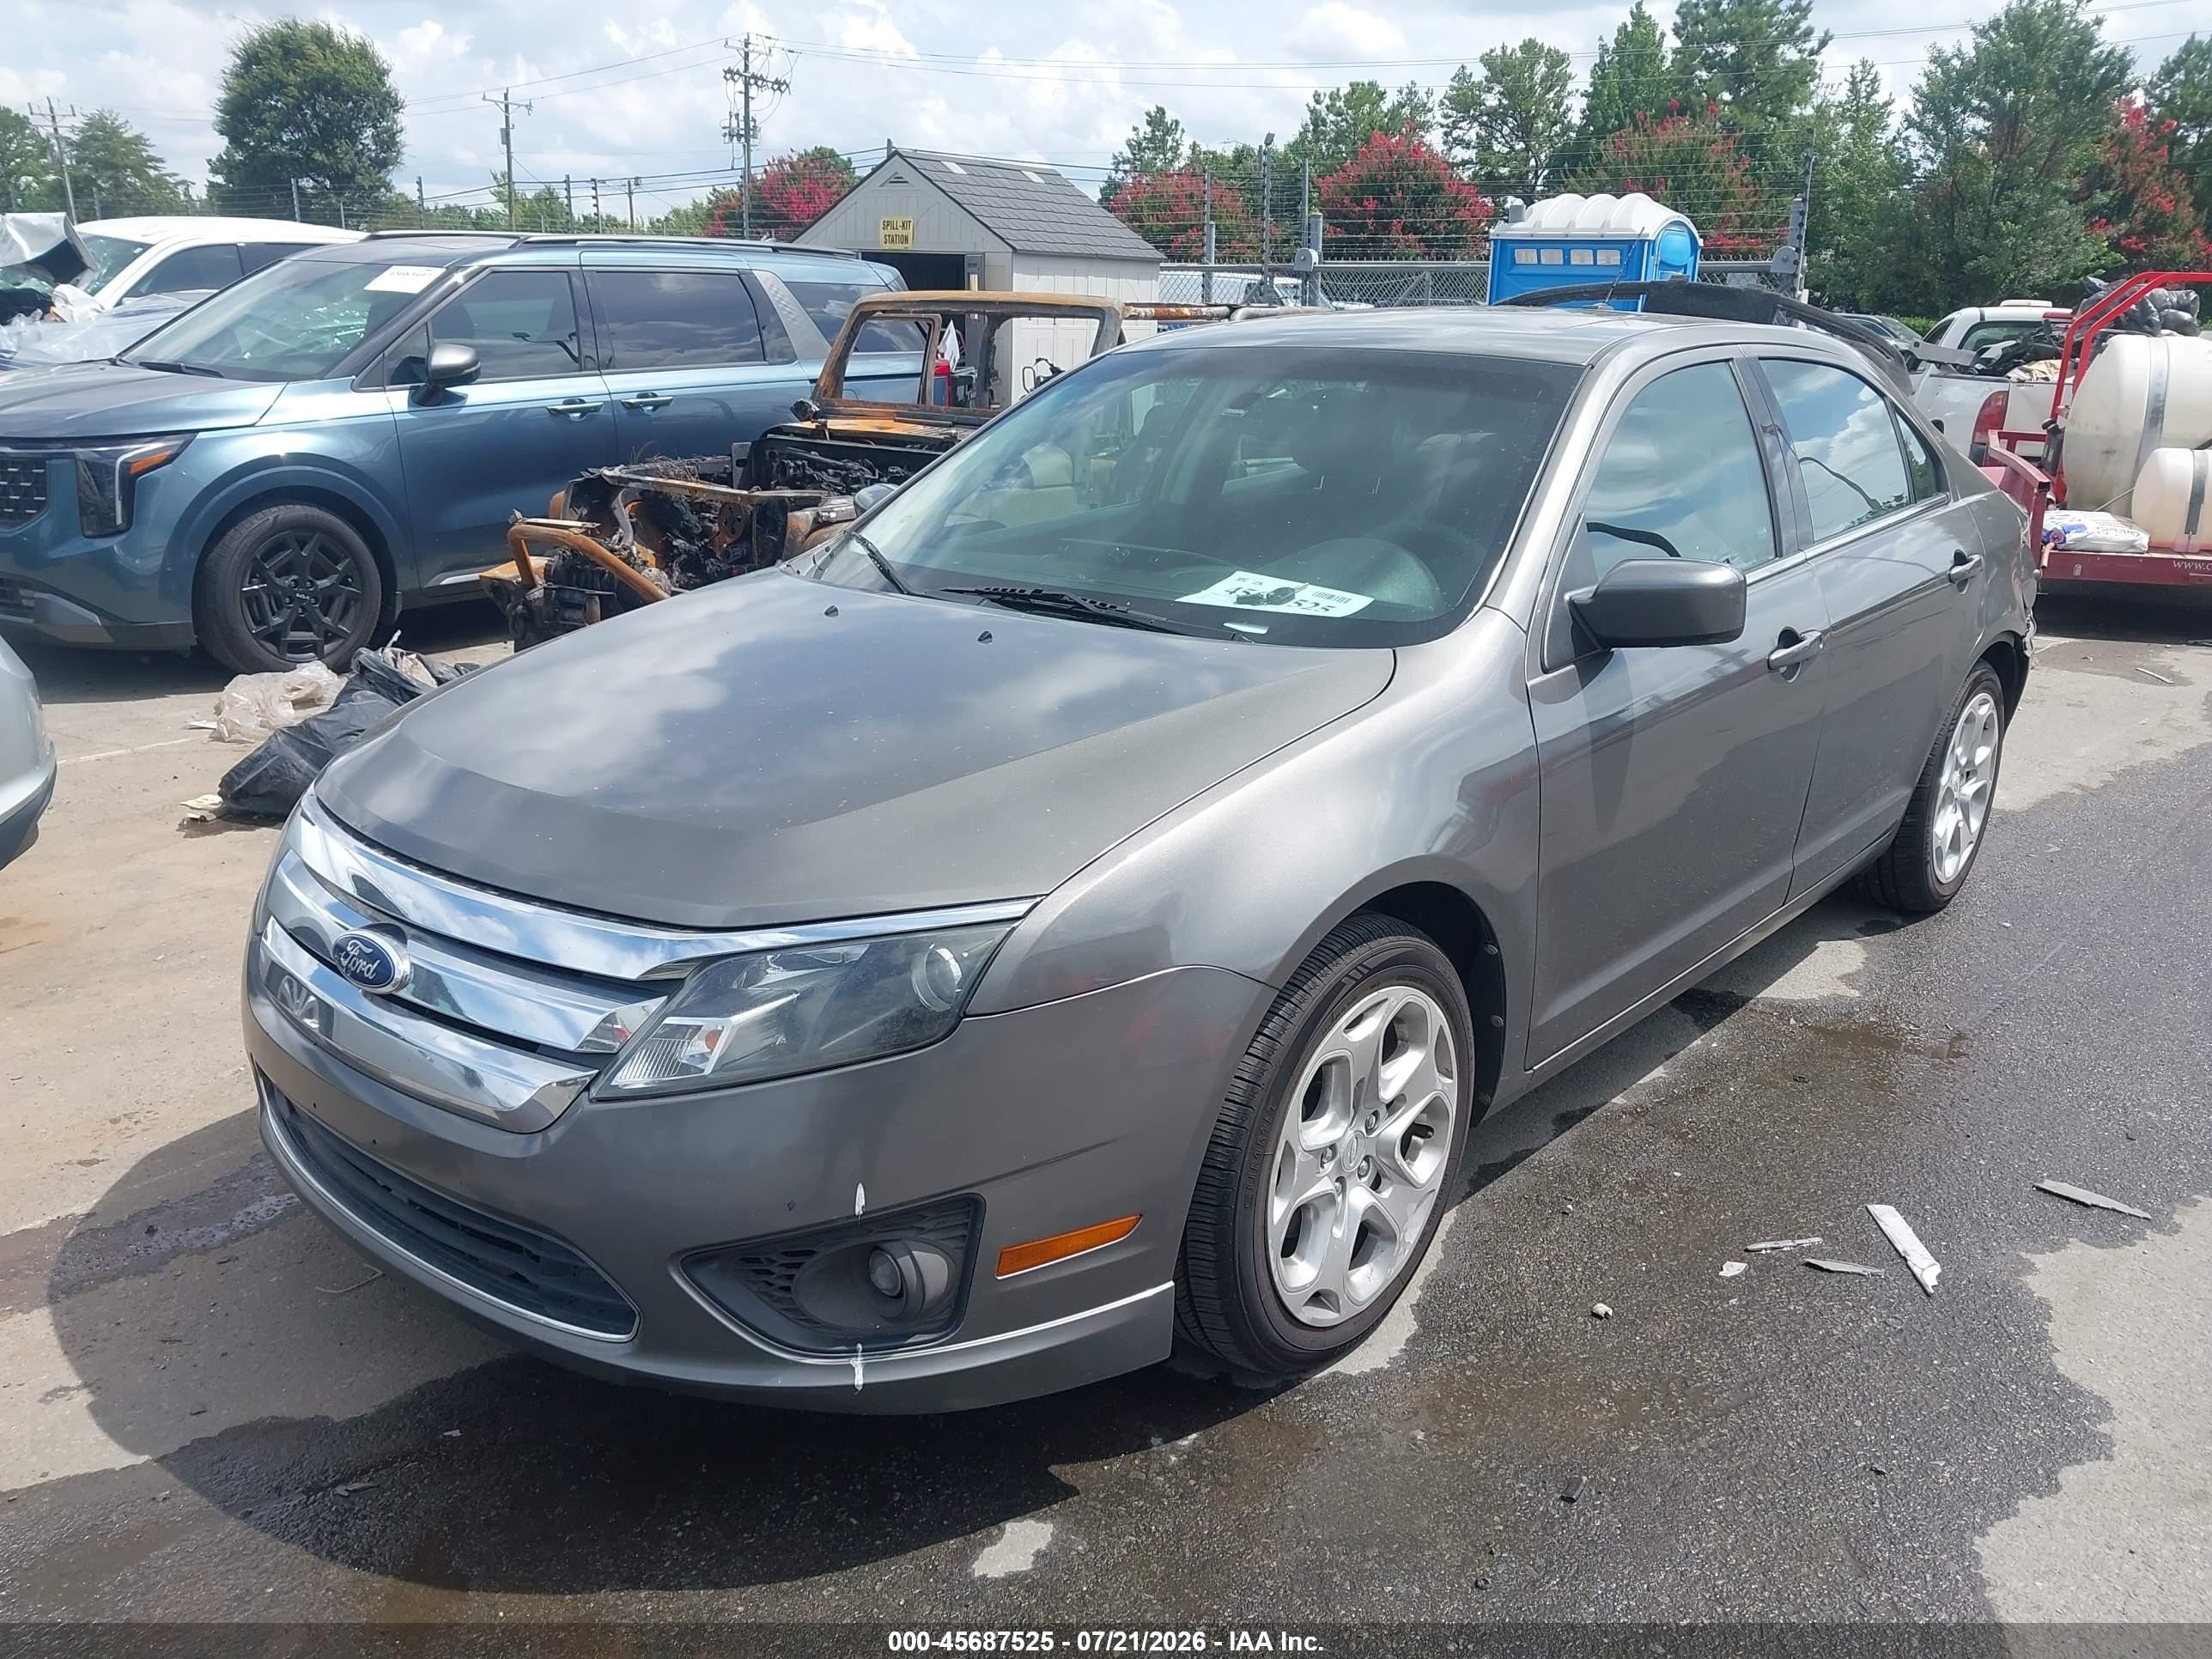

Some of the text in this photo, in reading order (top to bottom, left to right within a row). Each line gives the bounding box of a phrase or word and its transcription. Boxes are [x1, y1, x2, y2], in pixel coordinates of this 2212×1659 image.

[882, 219, 912, 231] SPILL-KIT
[884, 234, 909, 245] STATION
[1224, 586, 1338, 613] 45525
[338, 939, 380, 980] Ford
[1243, 1099, 1278, 1209] SUMMIT
